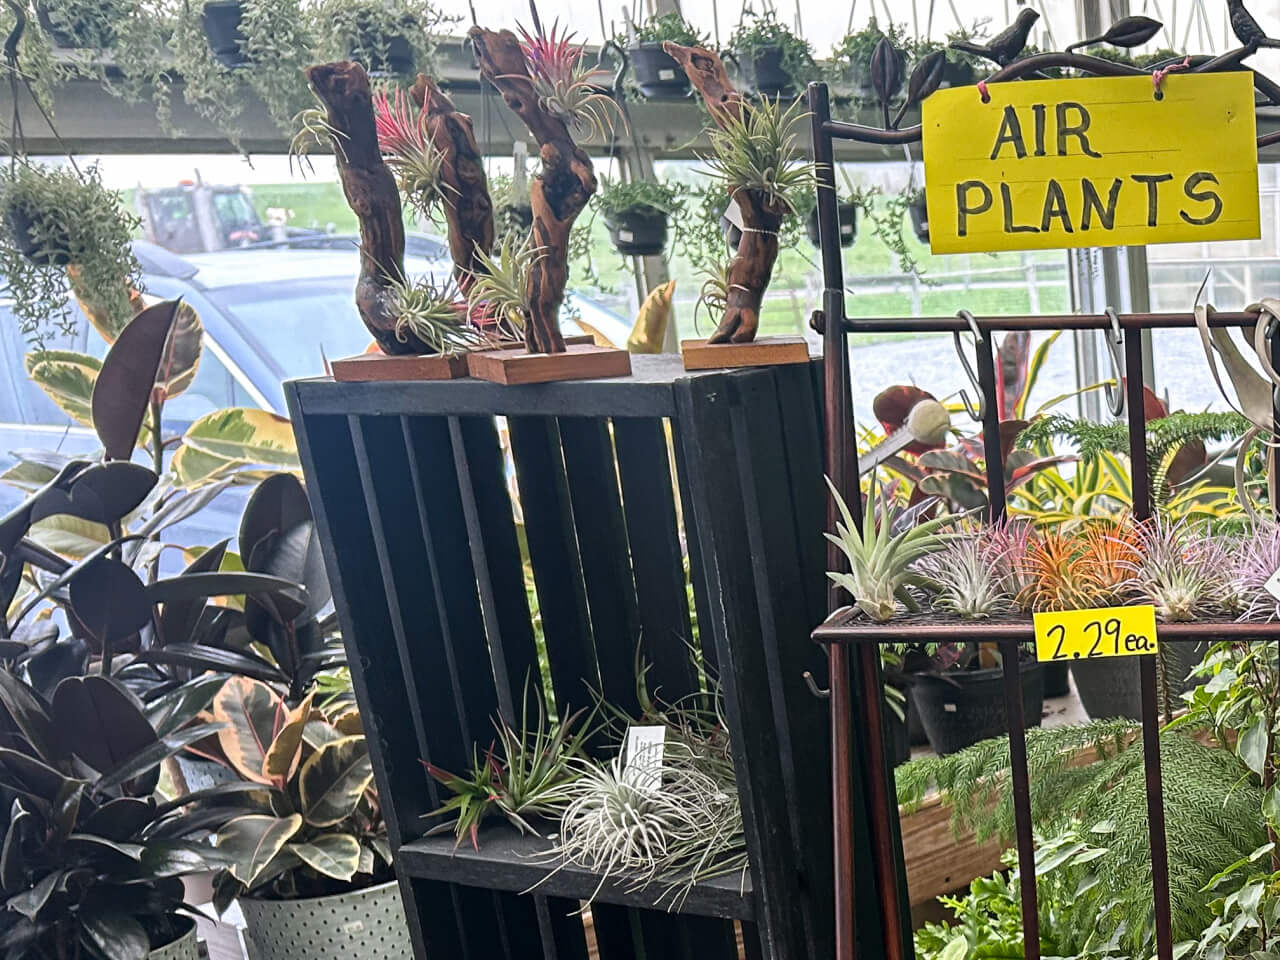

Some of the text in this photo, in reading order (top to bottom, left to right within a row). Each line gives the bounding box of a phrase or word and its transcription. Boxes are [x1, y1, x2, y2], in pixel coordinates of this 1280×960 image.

[990, 102, 1102, 160] AIR
[956, 171, 1223, 237] PLANTS
[1046, 618, 1121, 660] 2.29
